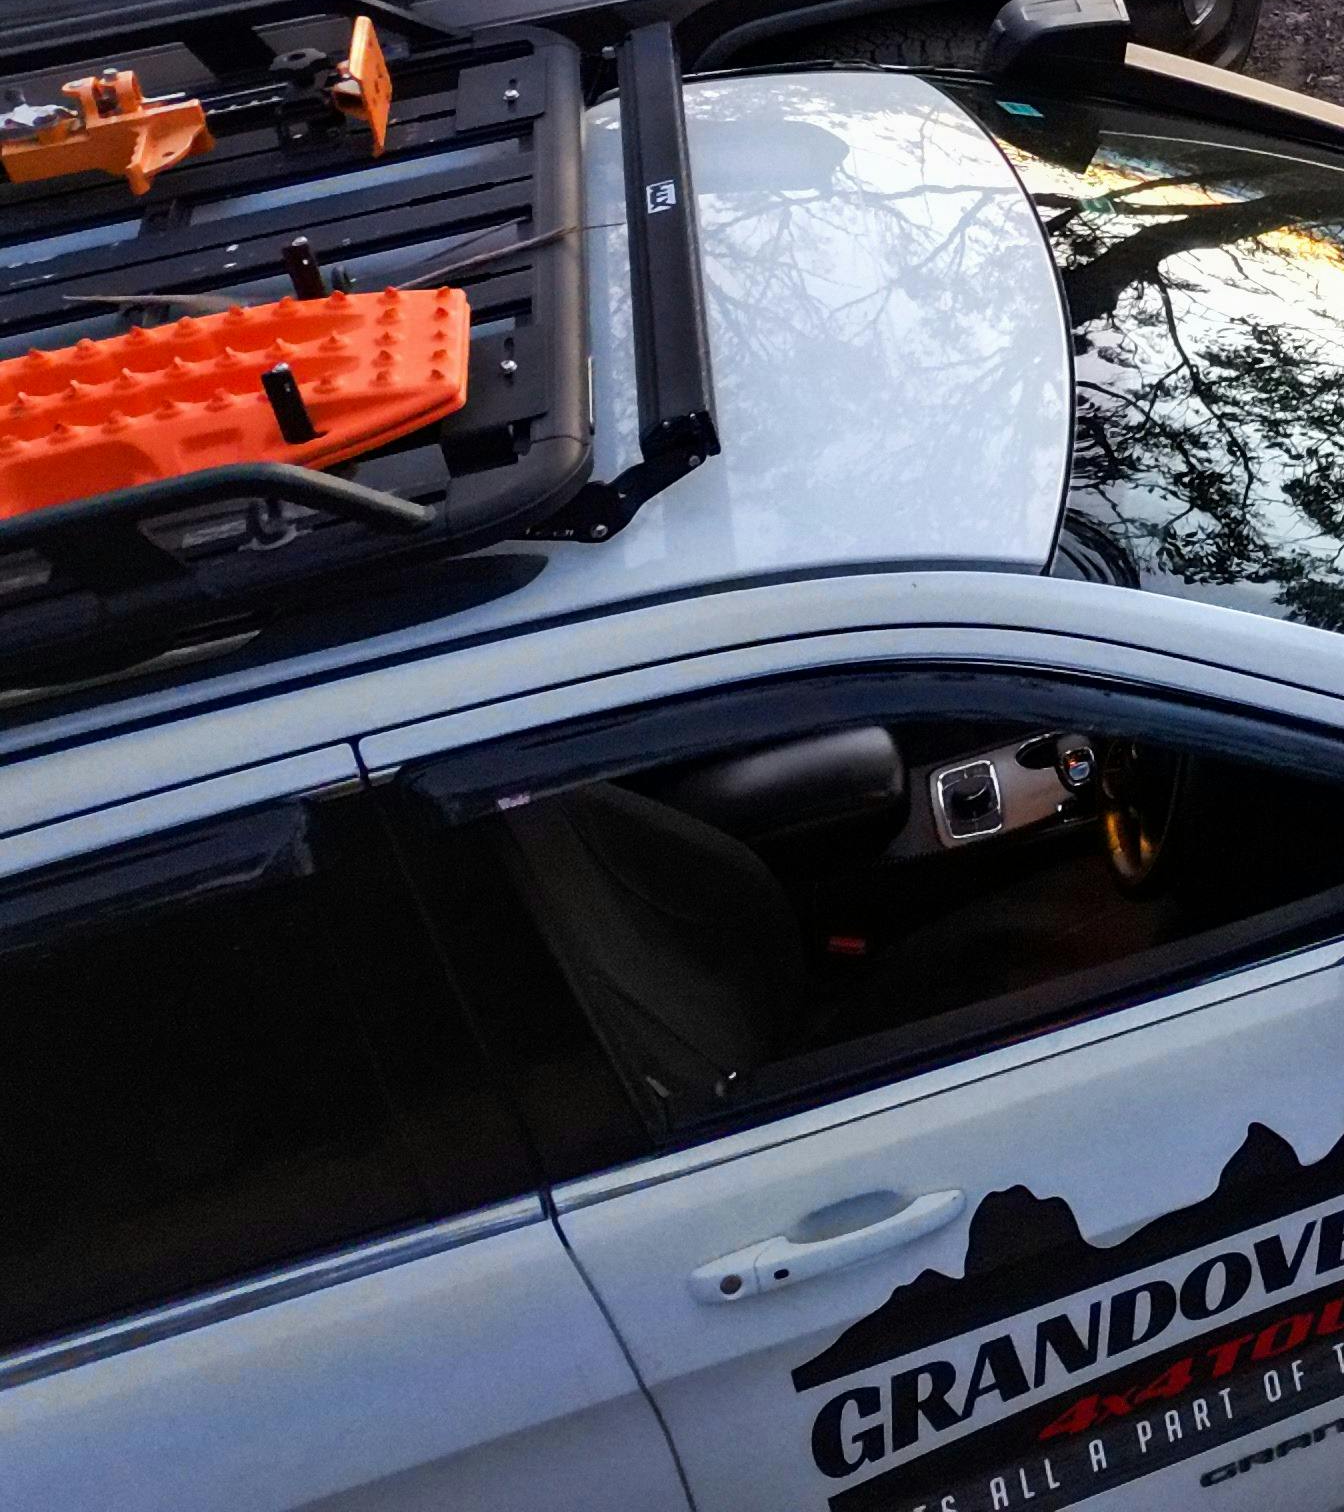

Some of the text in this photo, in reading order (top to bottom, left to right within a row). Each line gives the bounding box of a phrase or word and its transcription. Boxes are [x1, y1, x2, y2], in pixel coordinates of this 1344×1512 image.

[989, 1458, 1061, 1510] ALL
[1088, 1439, 1107, 1472] A
[1136, 1387, 1233, 1453] PART
[1263, 1359, 1304, 1402] OF
